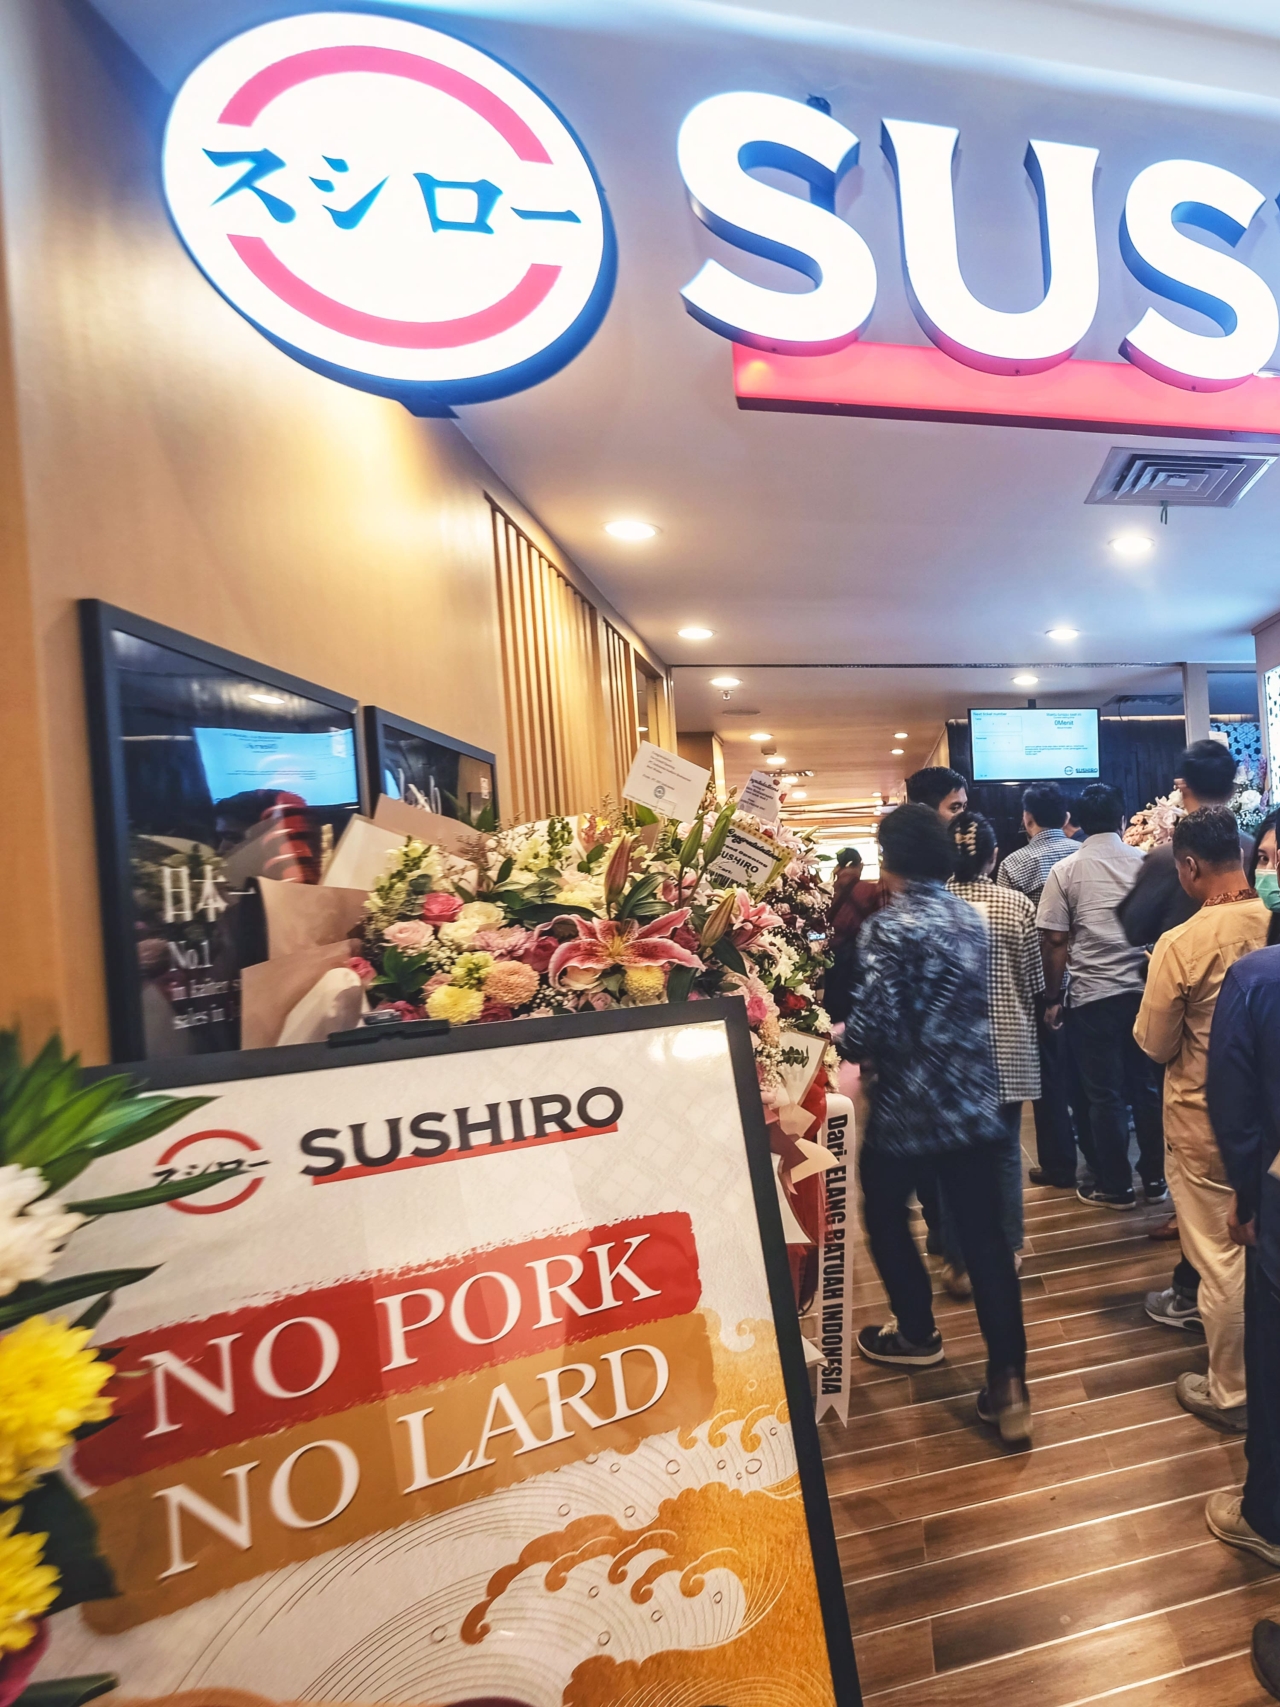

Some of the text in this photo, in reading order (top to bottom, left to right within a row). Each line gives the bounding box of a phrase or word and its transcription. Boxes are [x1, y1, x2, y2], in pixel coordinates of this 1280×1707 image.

[202, 148, 581, 234] スシロー
[720, 851, 759, 873] USHIRO
[300, 1086, 623, 1177] SUSHIRO
[825, 1165, 846, 1225] ELANG
[822, 1228, 845, 1301] BATUAH
[140, 1234, 661, 1438] NO PORK
[821, 1302, 844, 1396] INDONESIA
[154, 1343, 670, 1582] NO LARD
